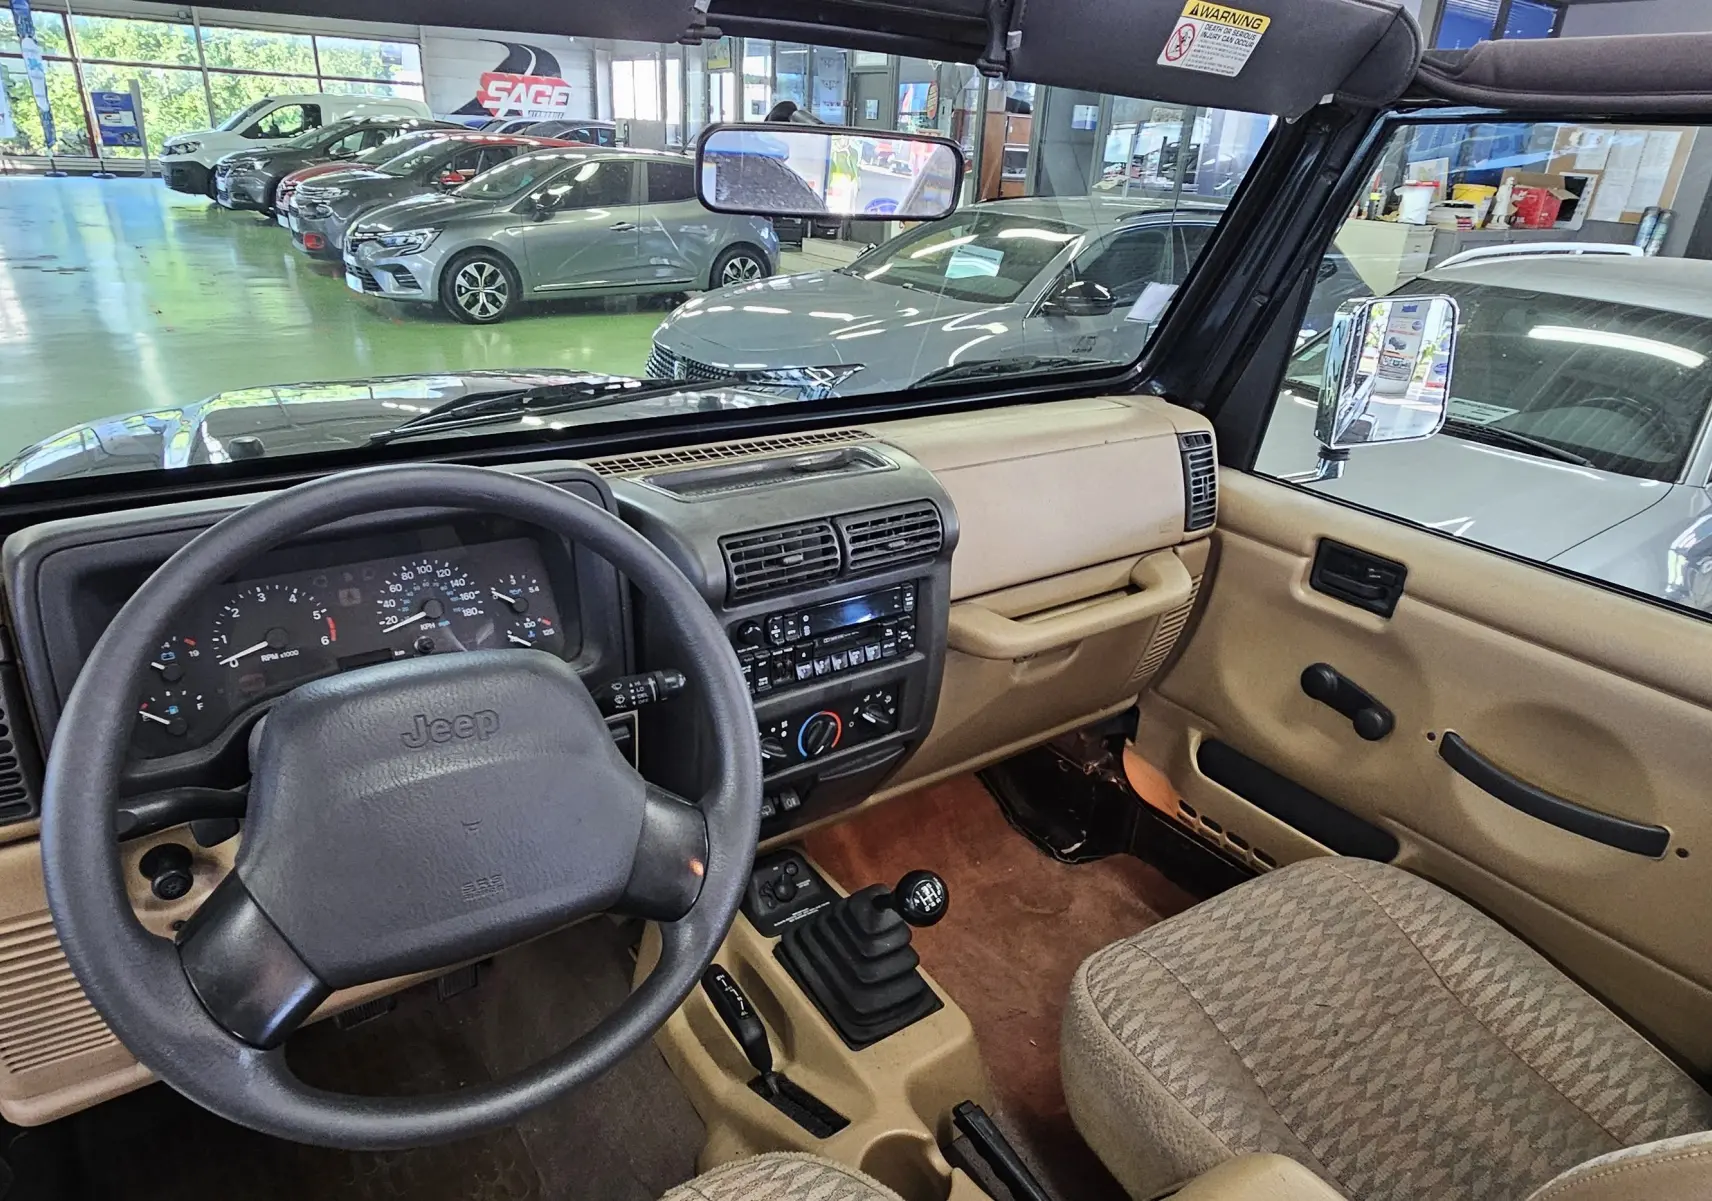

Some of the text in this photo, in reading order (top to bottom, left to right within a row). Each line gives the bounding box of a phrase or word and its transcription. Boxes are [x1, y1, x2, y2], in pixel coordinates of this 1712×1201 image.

[1200, 4, 1264, 30] WARNING
[1204, 23, 1256, 41] DEATH OR SERIOUS
[1200, 32, 1255, 48] INJURY CAN OCCUR
[482, 80, 572, 118] SAGE
[416, 564, 433, 574] 100
[436, 568, 451, 578] 120
[401, 571, 414, 580] 80
[389, 583, 402, 593] 60
[450, 578, 466, 588] 140
[257, 592, 266, 602] 3
[289, 594, 297, 603] 4
[460, 591, 475, 601] 160
[383, 599, 396, 608] 40
[231, 608, 240, 618] 2
[313, 610, 321, 620] 5
[462, 607, 478, 617] 180
[385, 615, 398, 625] 20
[420, 622, 436, 631] KPH
[221, 635, 228, 644] 1
[321, 636, 330, 645] 6
[188, 649, 200, 657] 19
[261, 652, 279, 661] RPM
[229, 658, 239, 668] 0
[197, 702, 204, 711] F
[401, 709, 500, 749] Jeep
